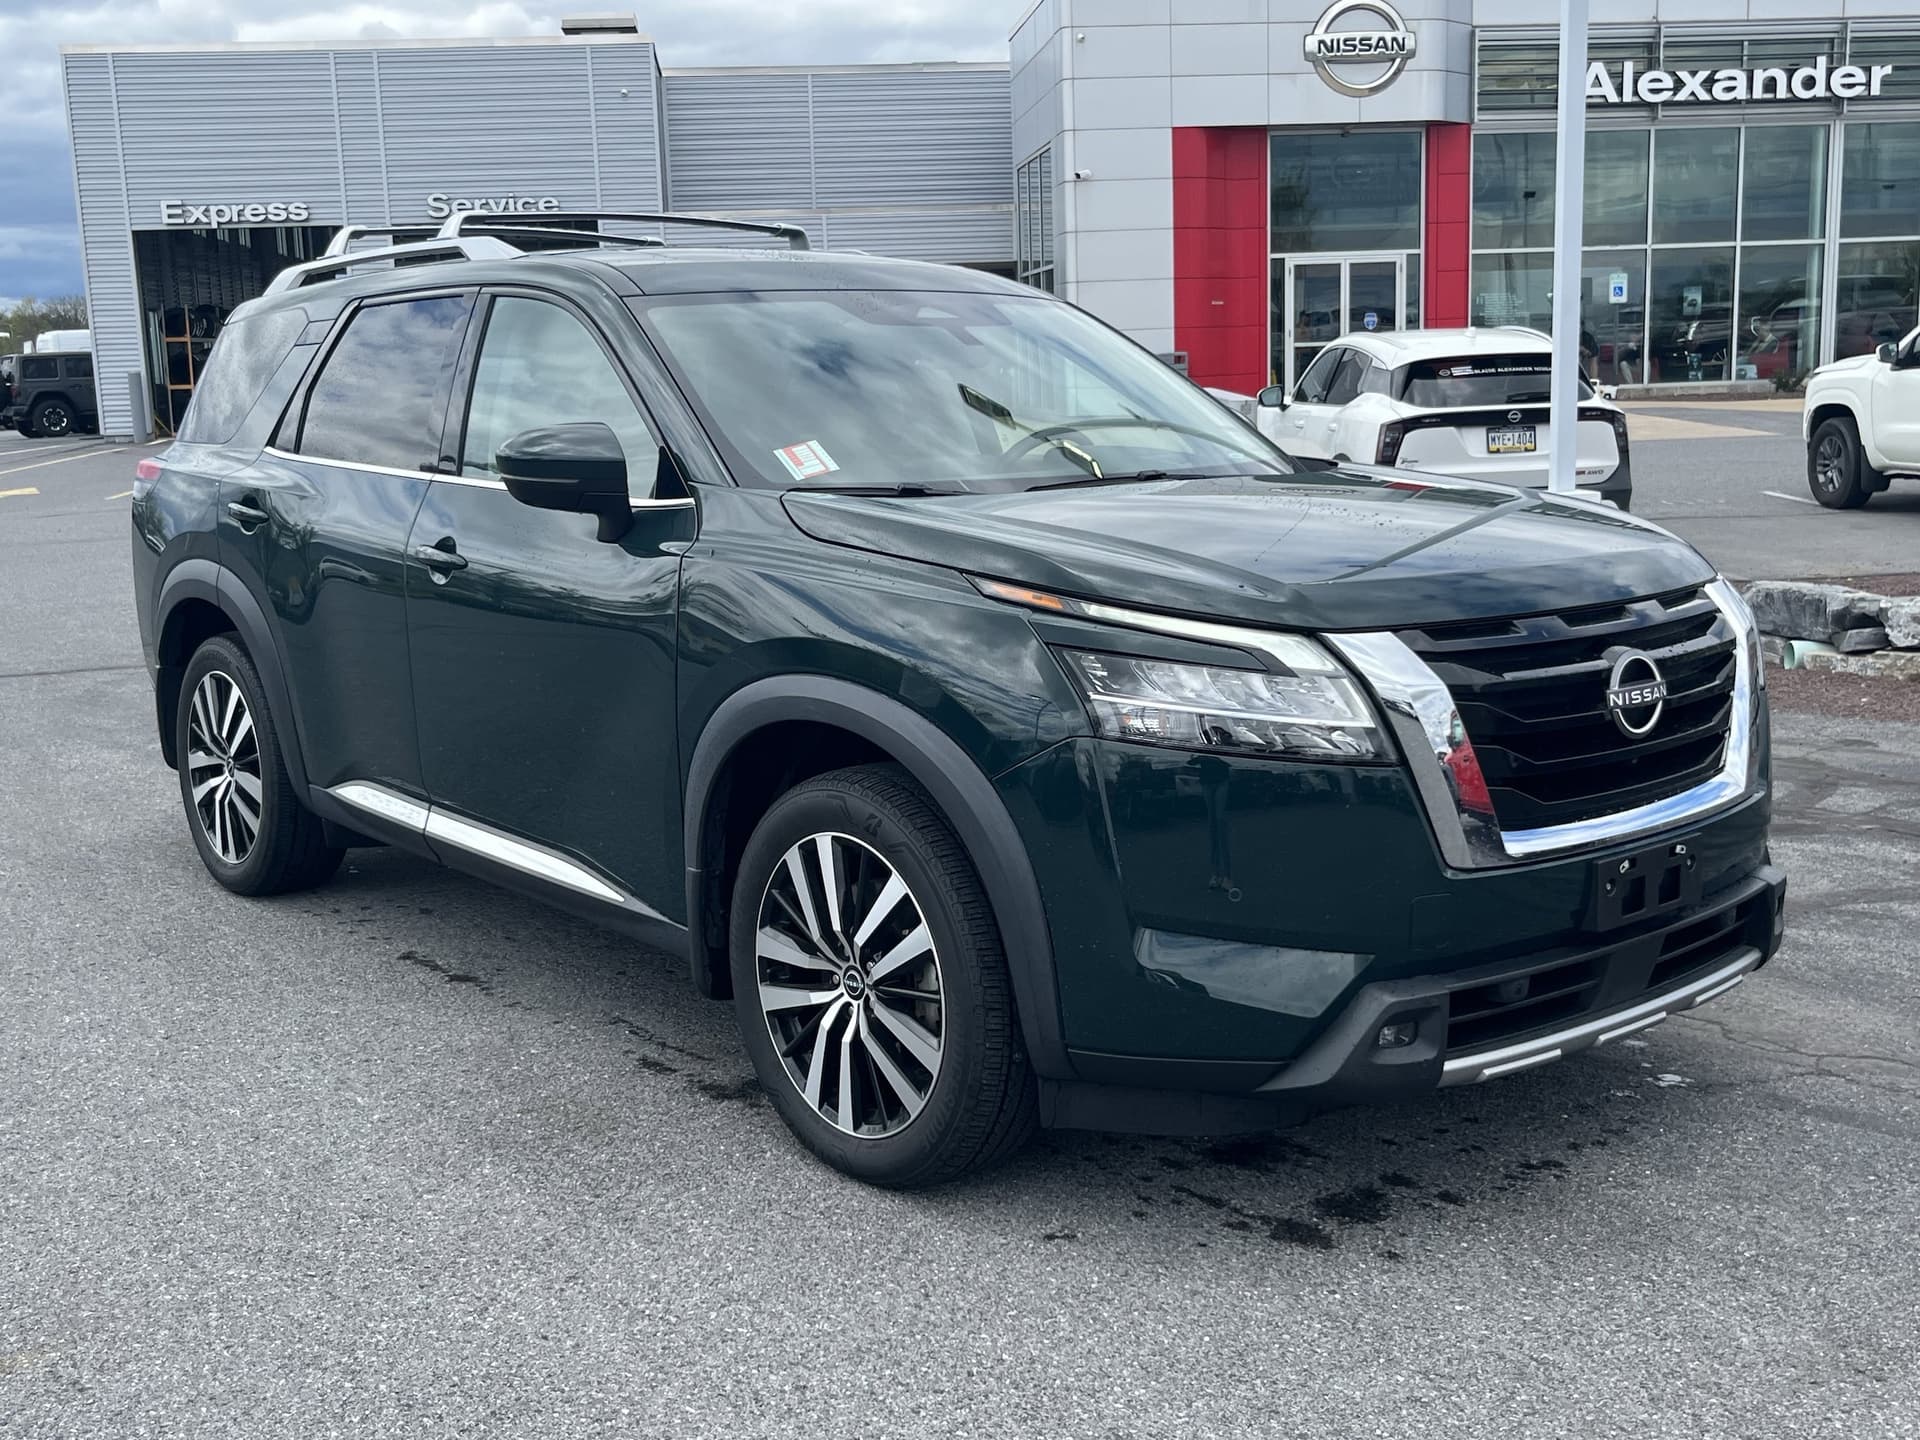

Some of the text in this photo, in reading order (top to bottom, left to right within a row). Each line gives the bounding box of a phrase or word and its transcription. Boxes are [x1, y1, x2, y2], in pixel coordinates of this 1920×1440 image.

[1317, 36, 1406, 56] NISSAN
[1585, 56, 1893, 103] Alexander
[160, 193, 560, 229] Express Service
[1609, 684, 1666, 706] NISSAN
